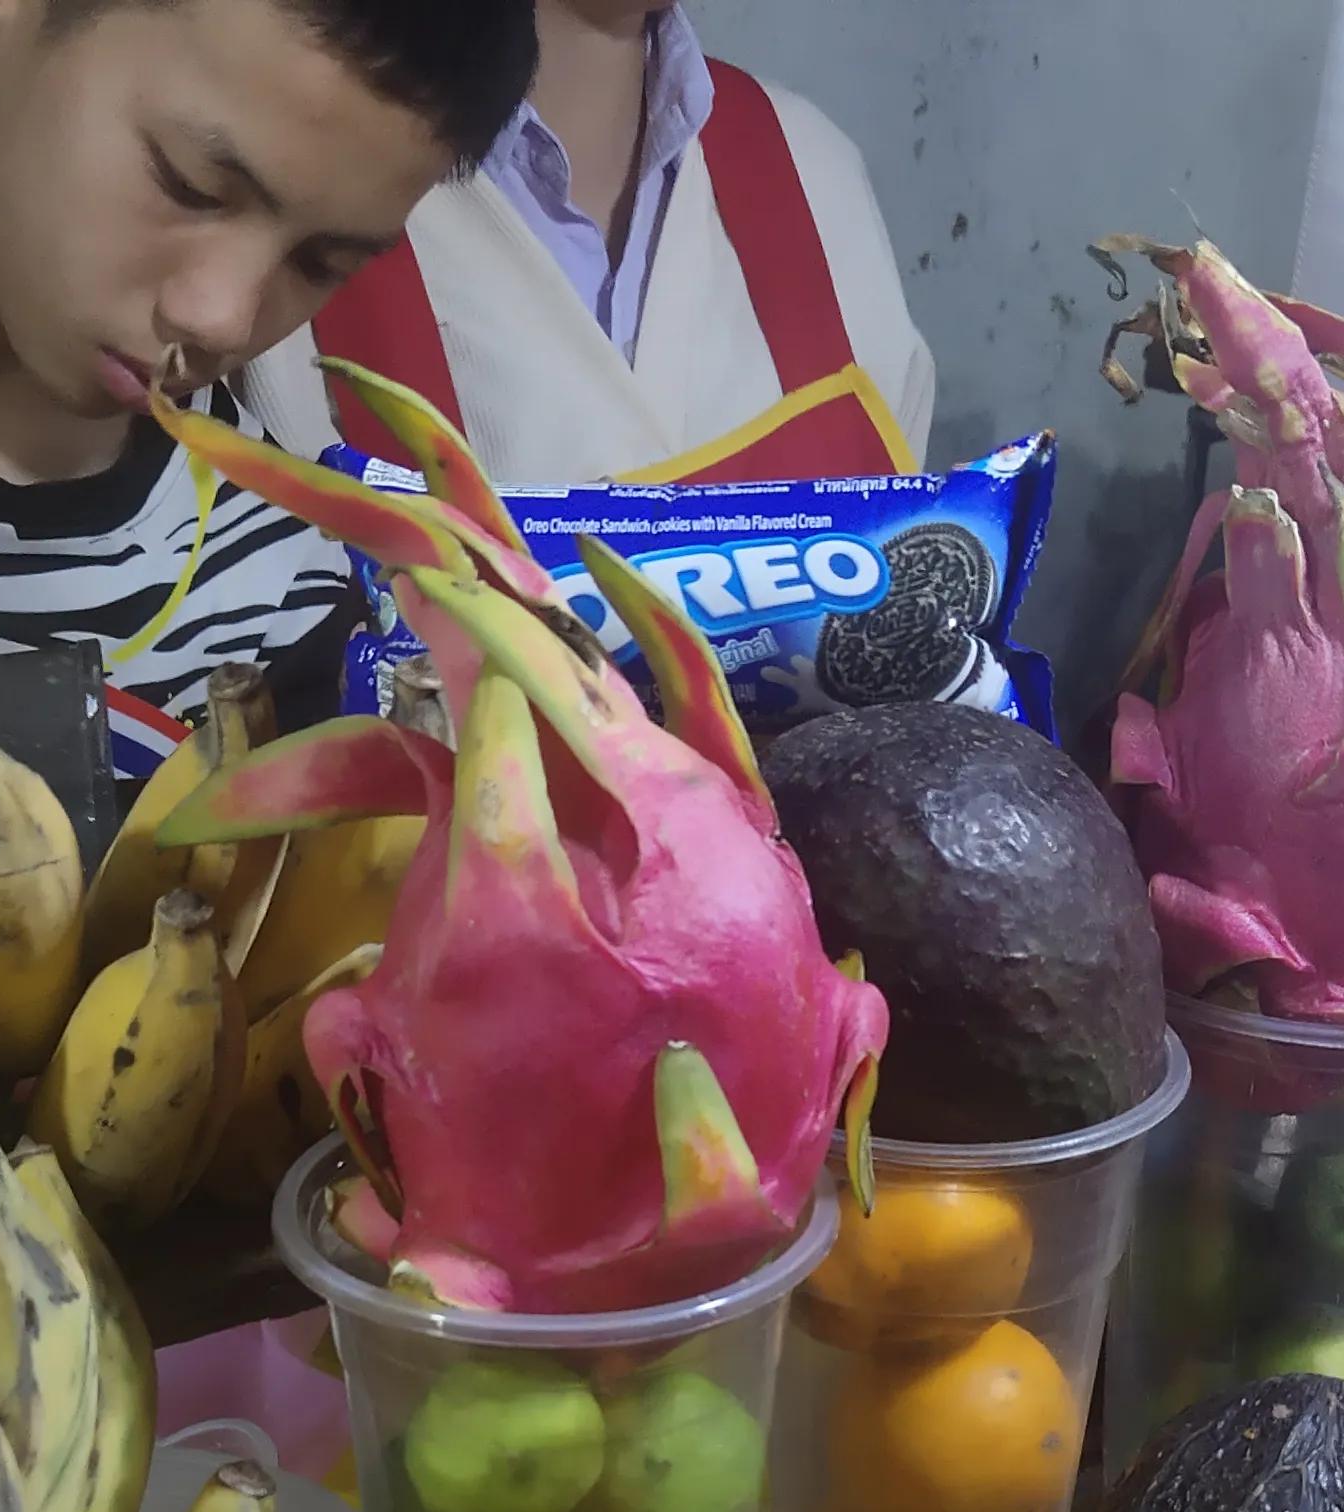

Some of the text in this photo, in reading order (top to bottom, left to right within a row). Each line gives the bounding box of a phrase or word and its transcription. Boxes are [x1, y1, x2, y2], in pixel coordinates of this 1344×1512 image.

[523, 517, 549, 534] Oreo
[550, 517, 600, 535] Chocolate
[601, 517, 650, 534] Sandwich
[692, 515, 715, 531] with
[716, 515, 750, 532] Vanilla
[751, 513, 797, 530] Flavored
[798, 513, 832, 529] Cream
